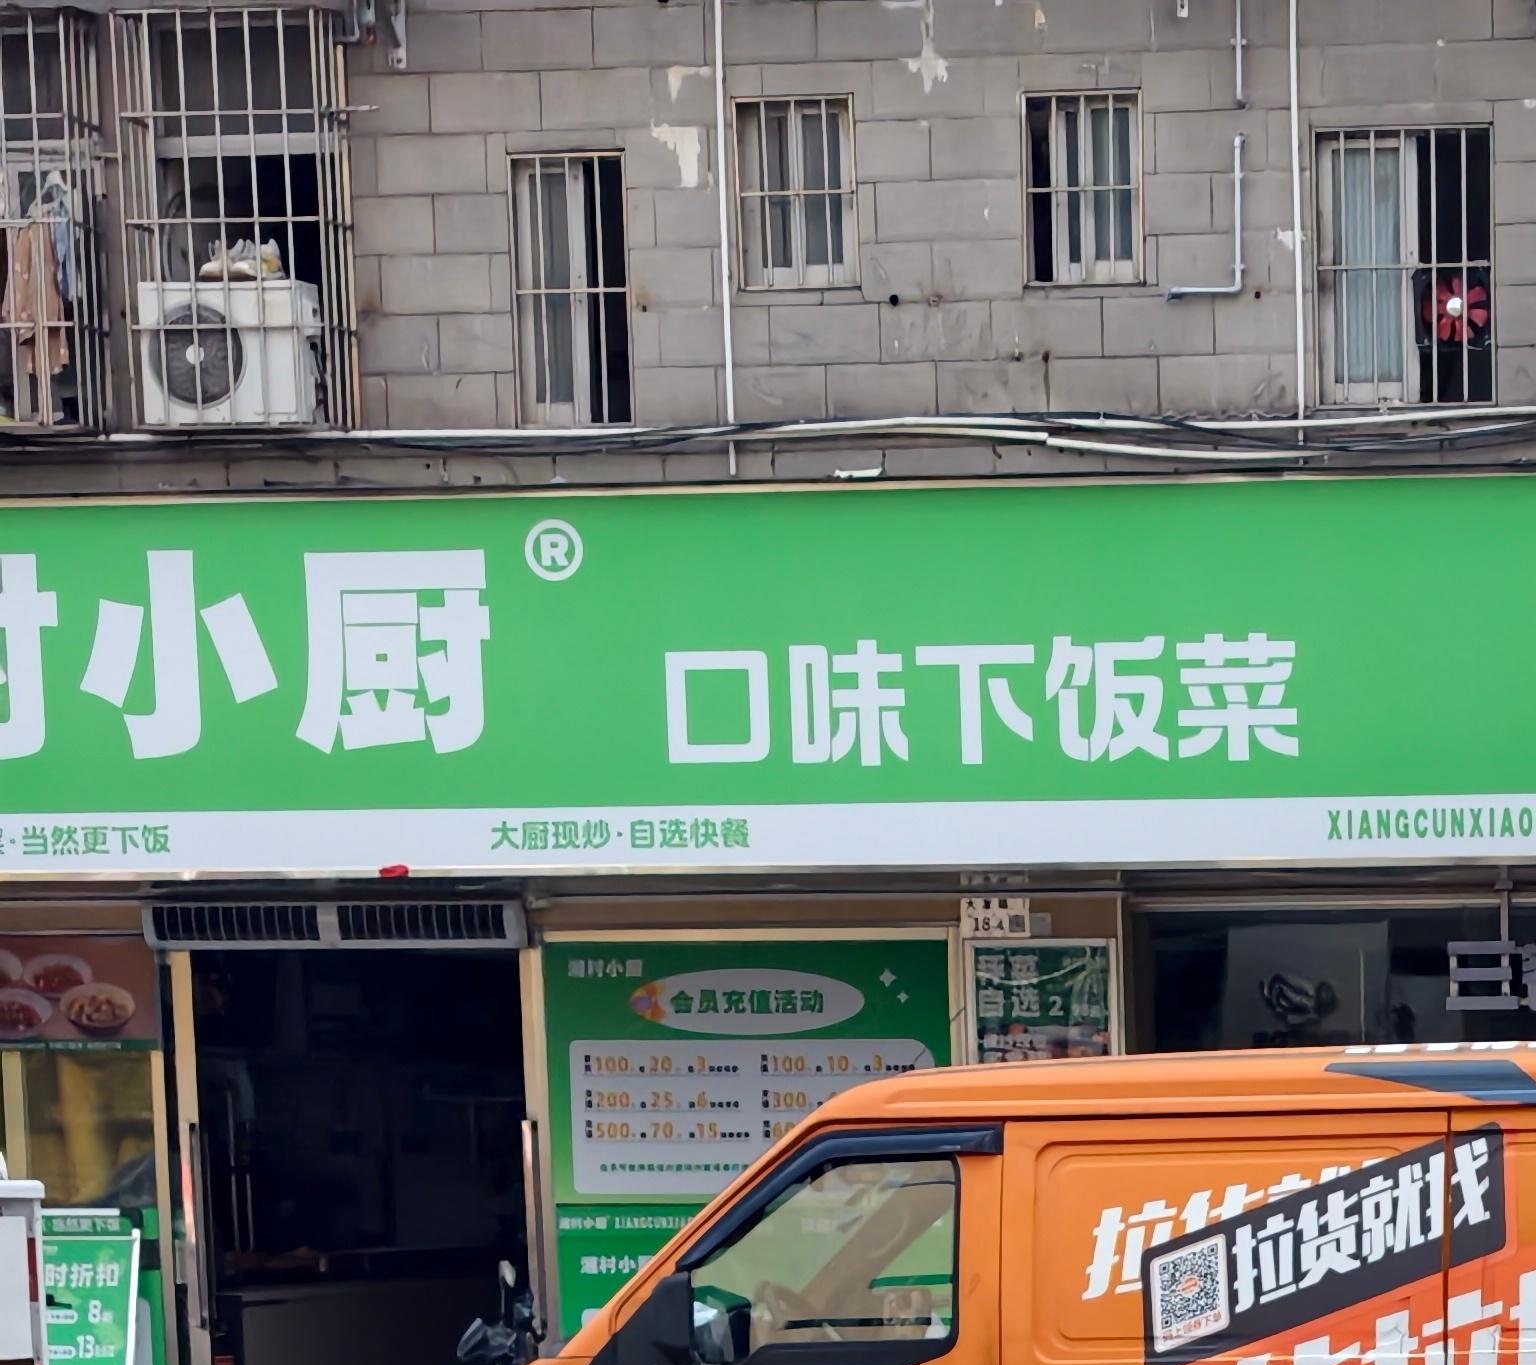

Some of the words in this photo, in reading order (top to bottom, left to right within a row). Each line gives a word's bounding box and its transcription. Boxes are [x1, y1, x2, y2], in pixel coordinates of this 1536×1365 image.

[664, 632, 1299, 766] 口味下饭菜
[0, 823, 171, 856] ·当然更下饭
[491, 818, 750, 850] 大厨现炒·自选快餐
[670, 989, 824, 1014] 会员充值活动
[1235, 1138, 1492, 1314] 拉货就找
